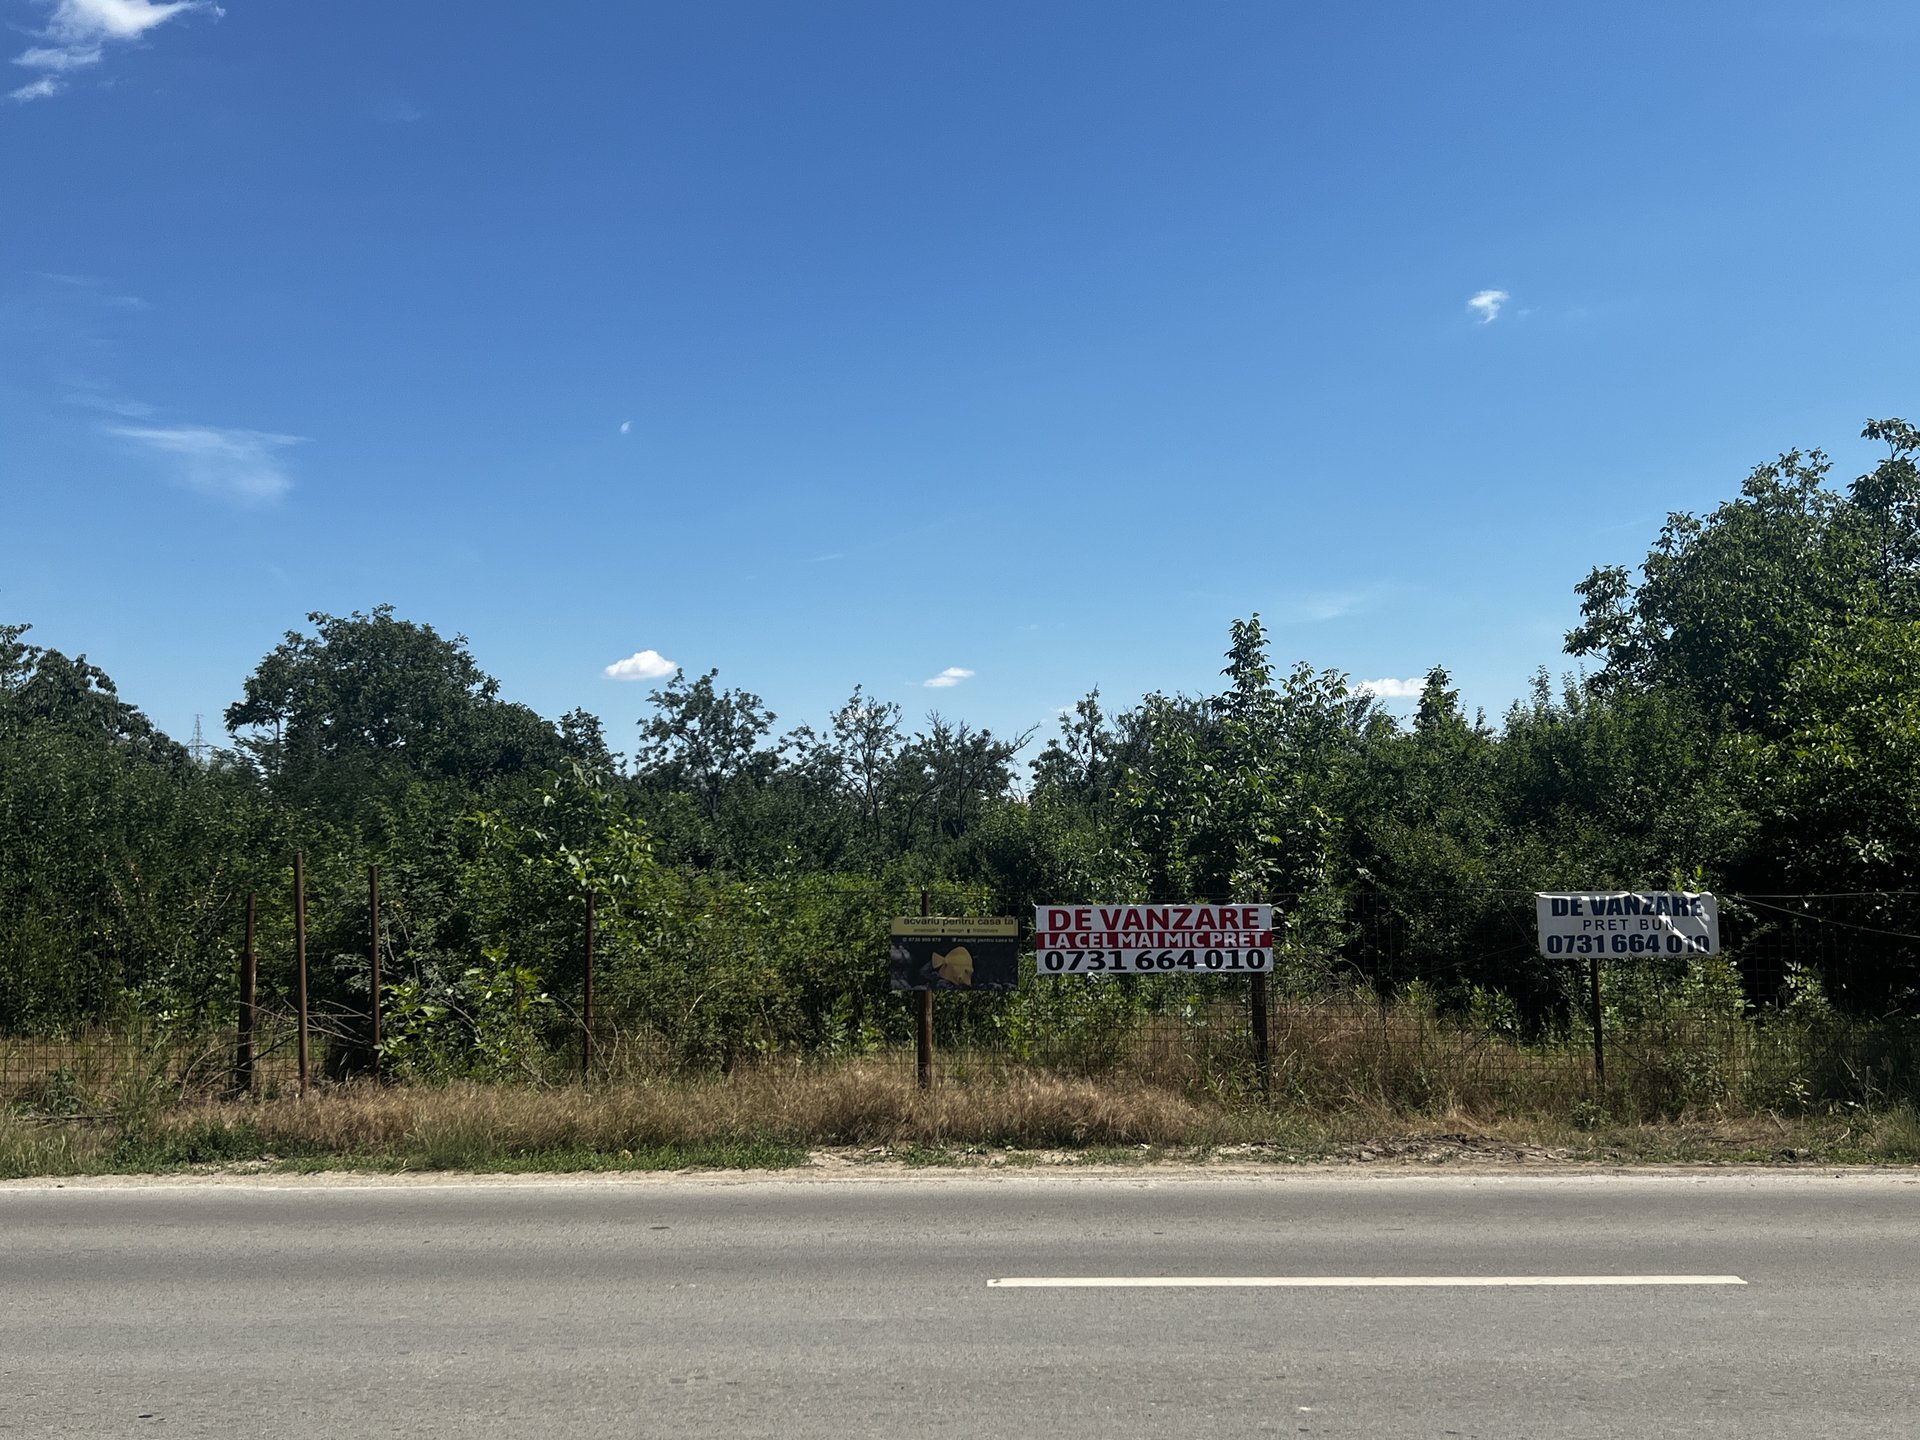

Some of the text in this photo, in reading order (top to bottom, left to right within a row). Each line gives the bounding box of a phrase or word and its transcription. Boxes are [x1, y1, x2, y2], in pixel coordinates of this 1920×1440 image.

[1552, 896, 1703, 917] DE VANZARE
[943, 918, 974, 926] pentru
[1048, 908, 1259, 931] DE VANZARE
[1583, 919, 1628, 931] PRET
[1044, 931, 1264, 949] LA CEL MAI MIC PRET
[1546, 934, 1605, 954] 0731
[1611, 934, 1661, 953] 664
[1044, 949, 1266, 971] 0731 664 010
